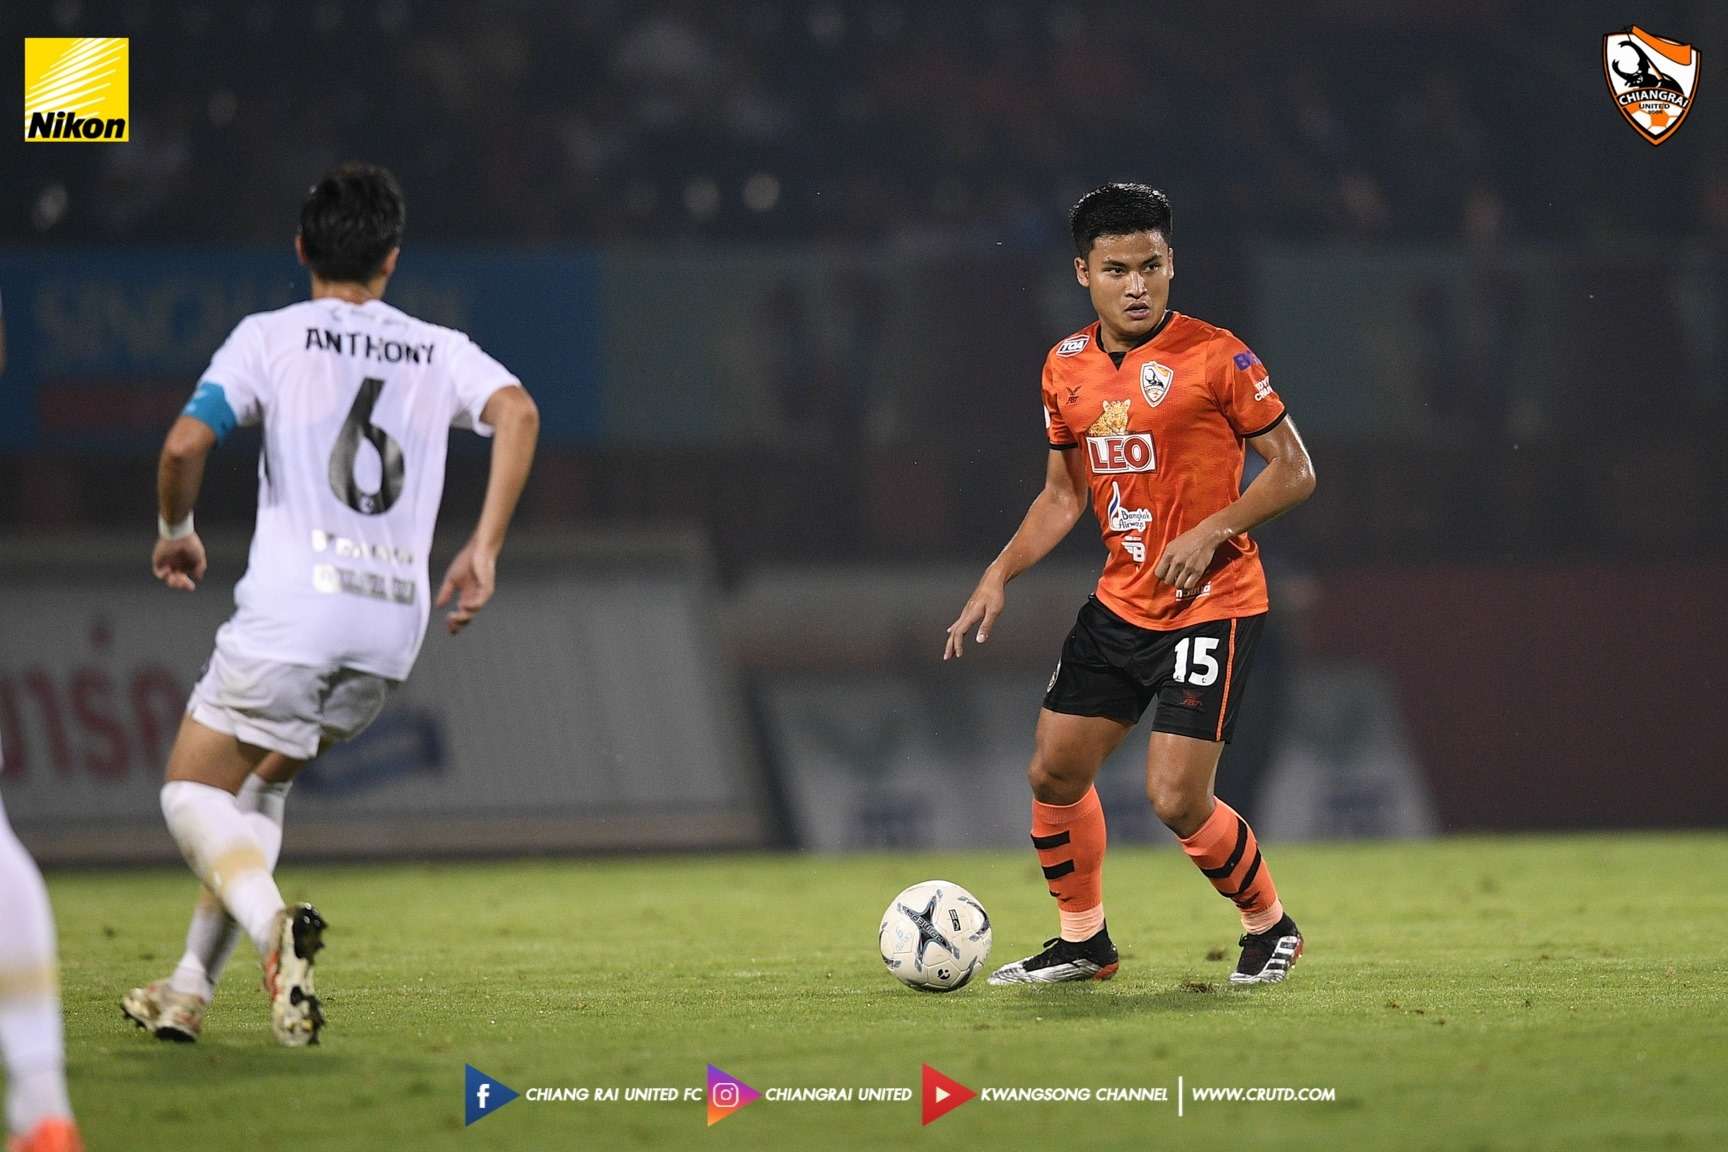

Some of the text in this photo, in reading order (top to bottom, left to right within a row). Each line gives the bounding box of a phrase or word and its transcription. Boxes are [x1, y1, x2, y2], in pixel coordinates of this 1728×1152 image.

[306, 328, 435, 364] ANTHONY
[1061, 340, 1085, 352] TOA
[328, 377, 405, 516] 6
[1088, 436, 1151, 470] LEO
[1120, 509, 1150, 522] Bangkok
[1173, 637, 1219, 686] 15
